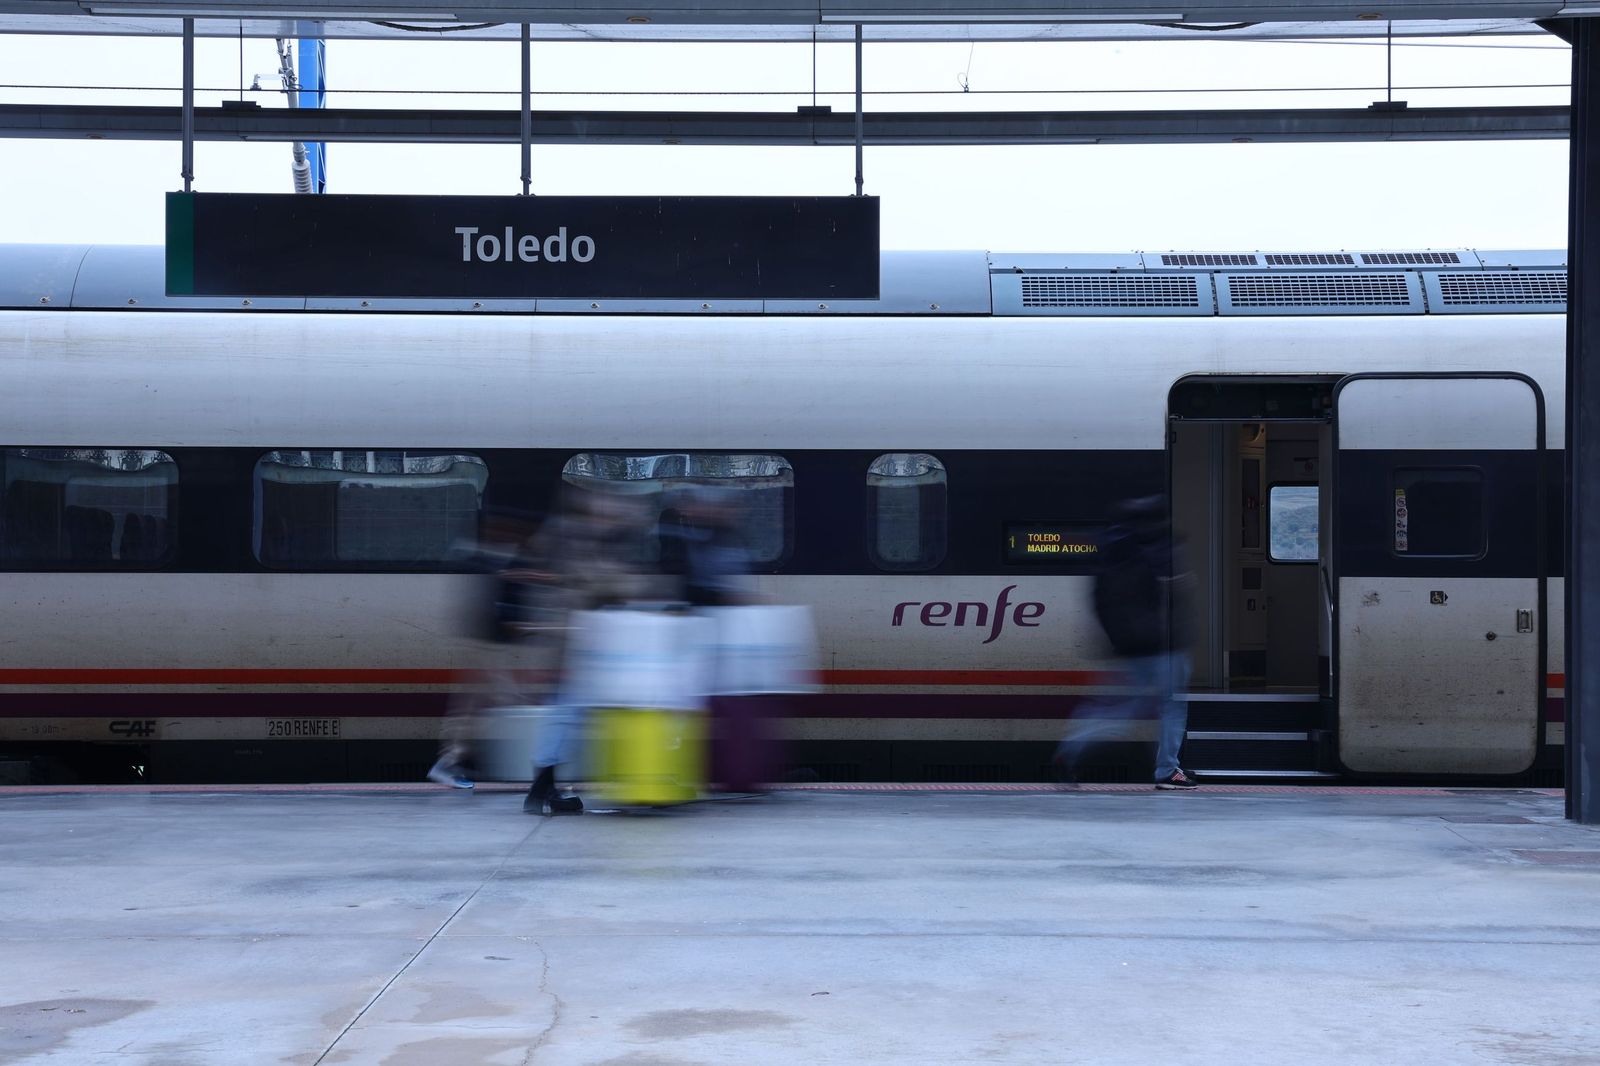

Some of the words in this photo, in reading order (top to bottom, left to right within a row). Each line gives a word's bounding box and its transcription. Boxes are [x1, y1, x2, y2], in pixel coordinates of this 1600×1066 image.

[454, 226, 595, 263] Toledo
[1028, 534, 1060, 542] TOLEDO
[1027, 544, 1060, 553] MADRID
[1062, 544, 1098, 553] ATOCHA
[892, 585, 1046, 644] renfe
[109, 720, 156, 737] CAF
[268, 721, 292, 736] 250
[294, 720, 329, 735] RENFE
